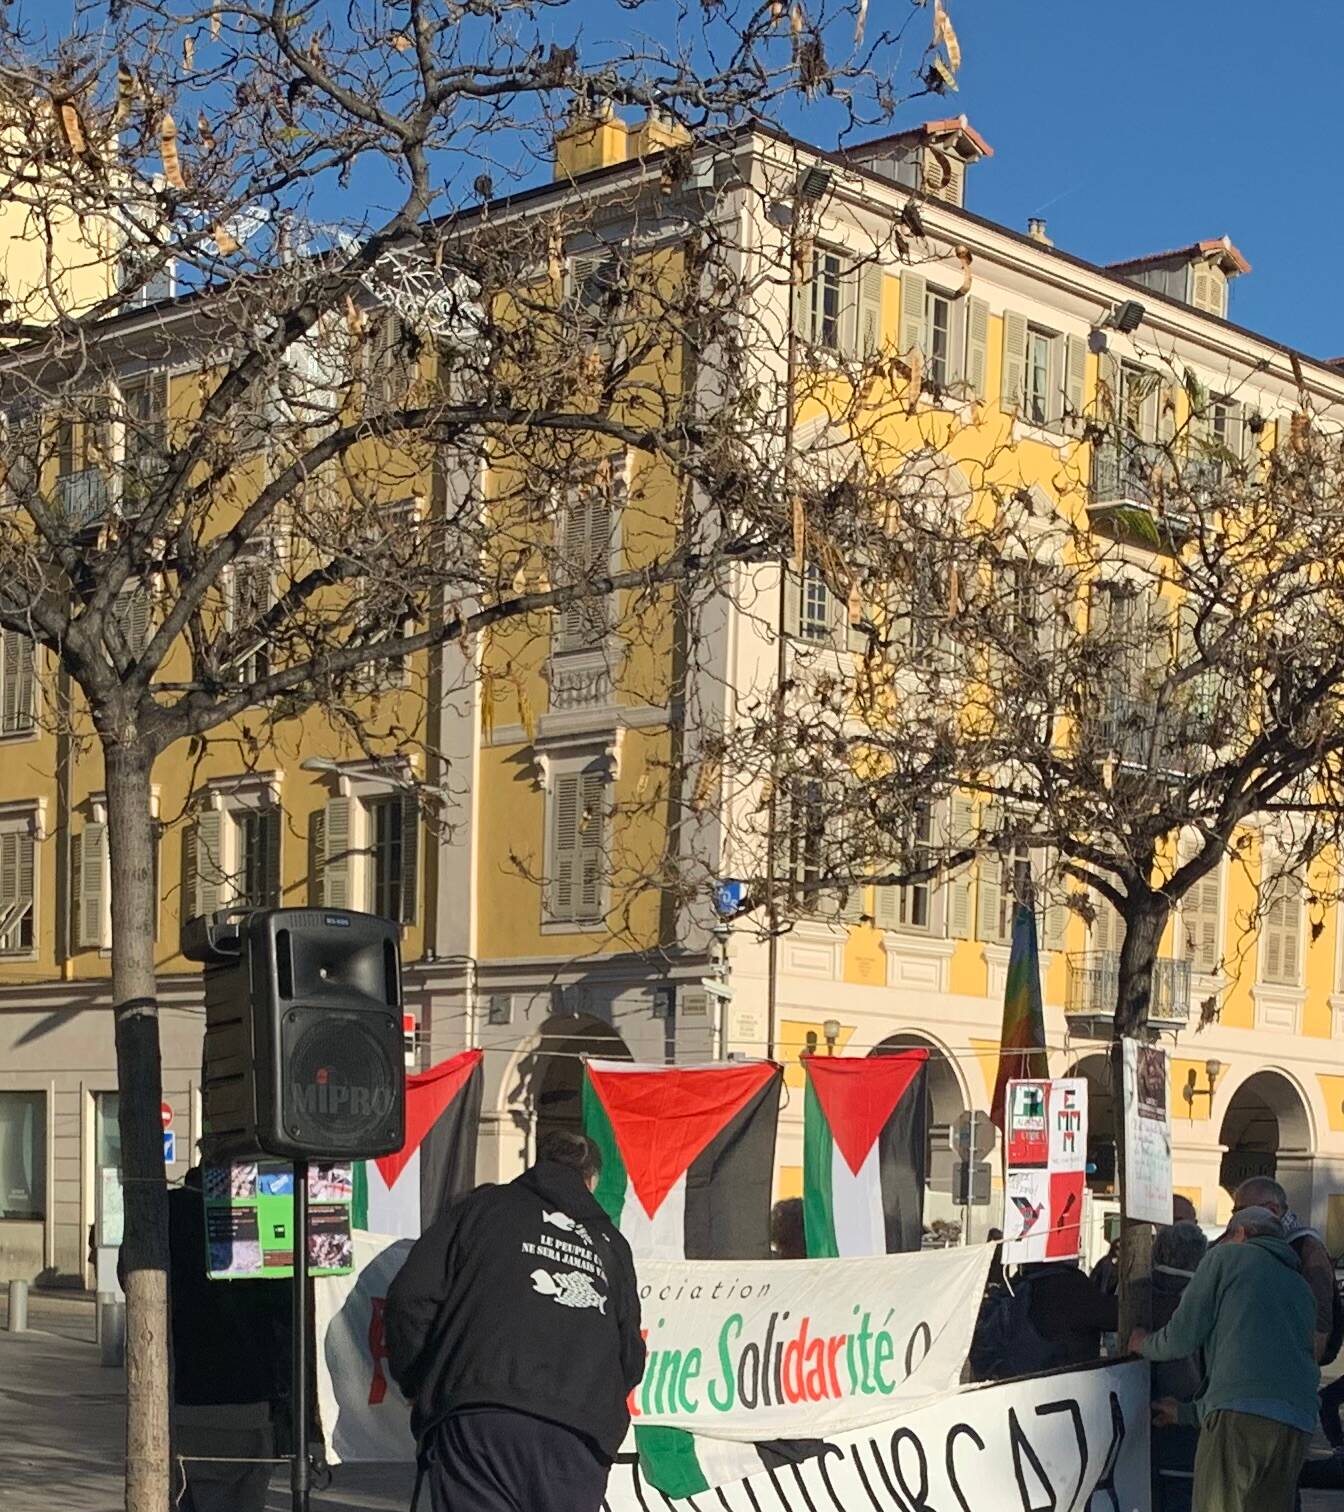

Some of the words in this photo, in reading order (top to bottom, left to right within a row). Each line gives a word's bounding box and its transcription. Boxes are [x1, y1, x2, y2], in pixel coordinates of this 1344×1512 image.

[521, 1242, 536, 1254] NE
[536, 1245, 561, 1262] SERA
[561, 1253, 595, 1274] JAMAIS
[540, 1234, 554, 1247] LE
[556, 1239, 593, 1261] PEUPLE
[640, 1278, 772, 1301] ociation
[708, 1304, 897, 1412] Solidarité
